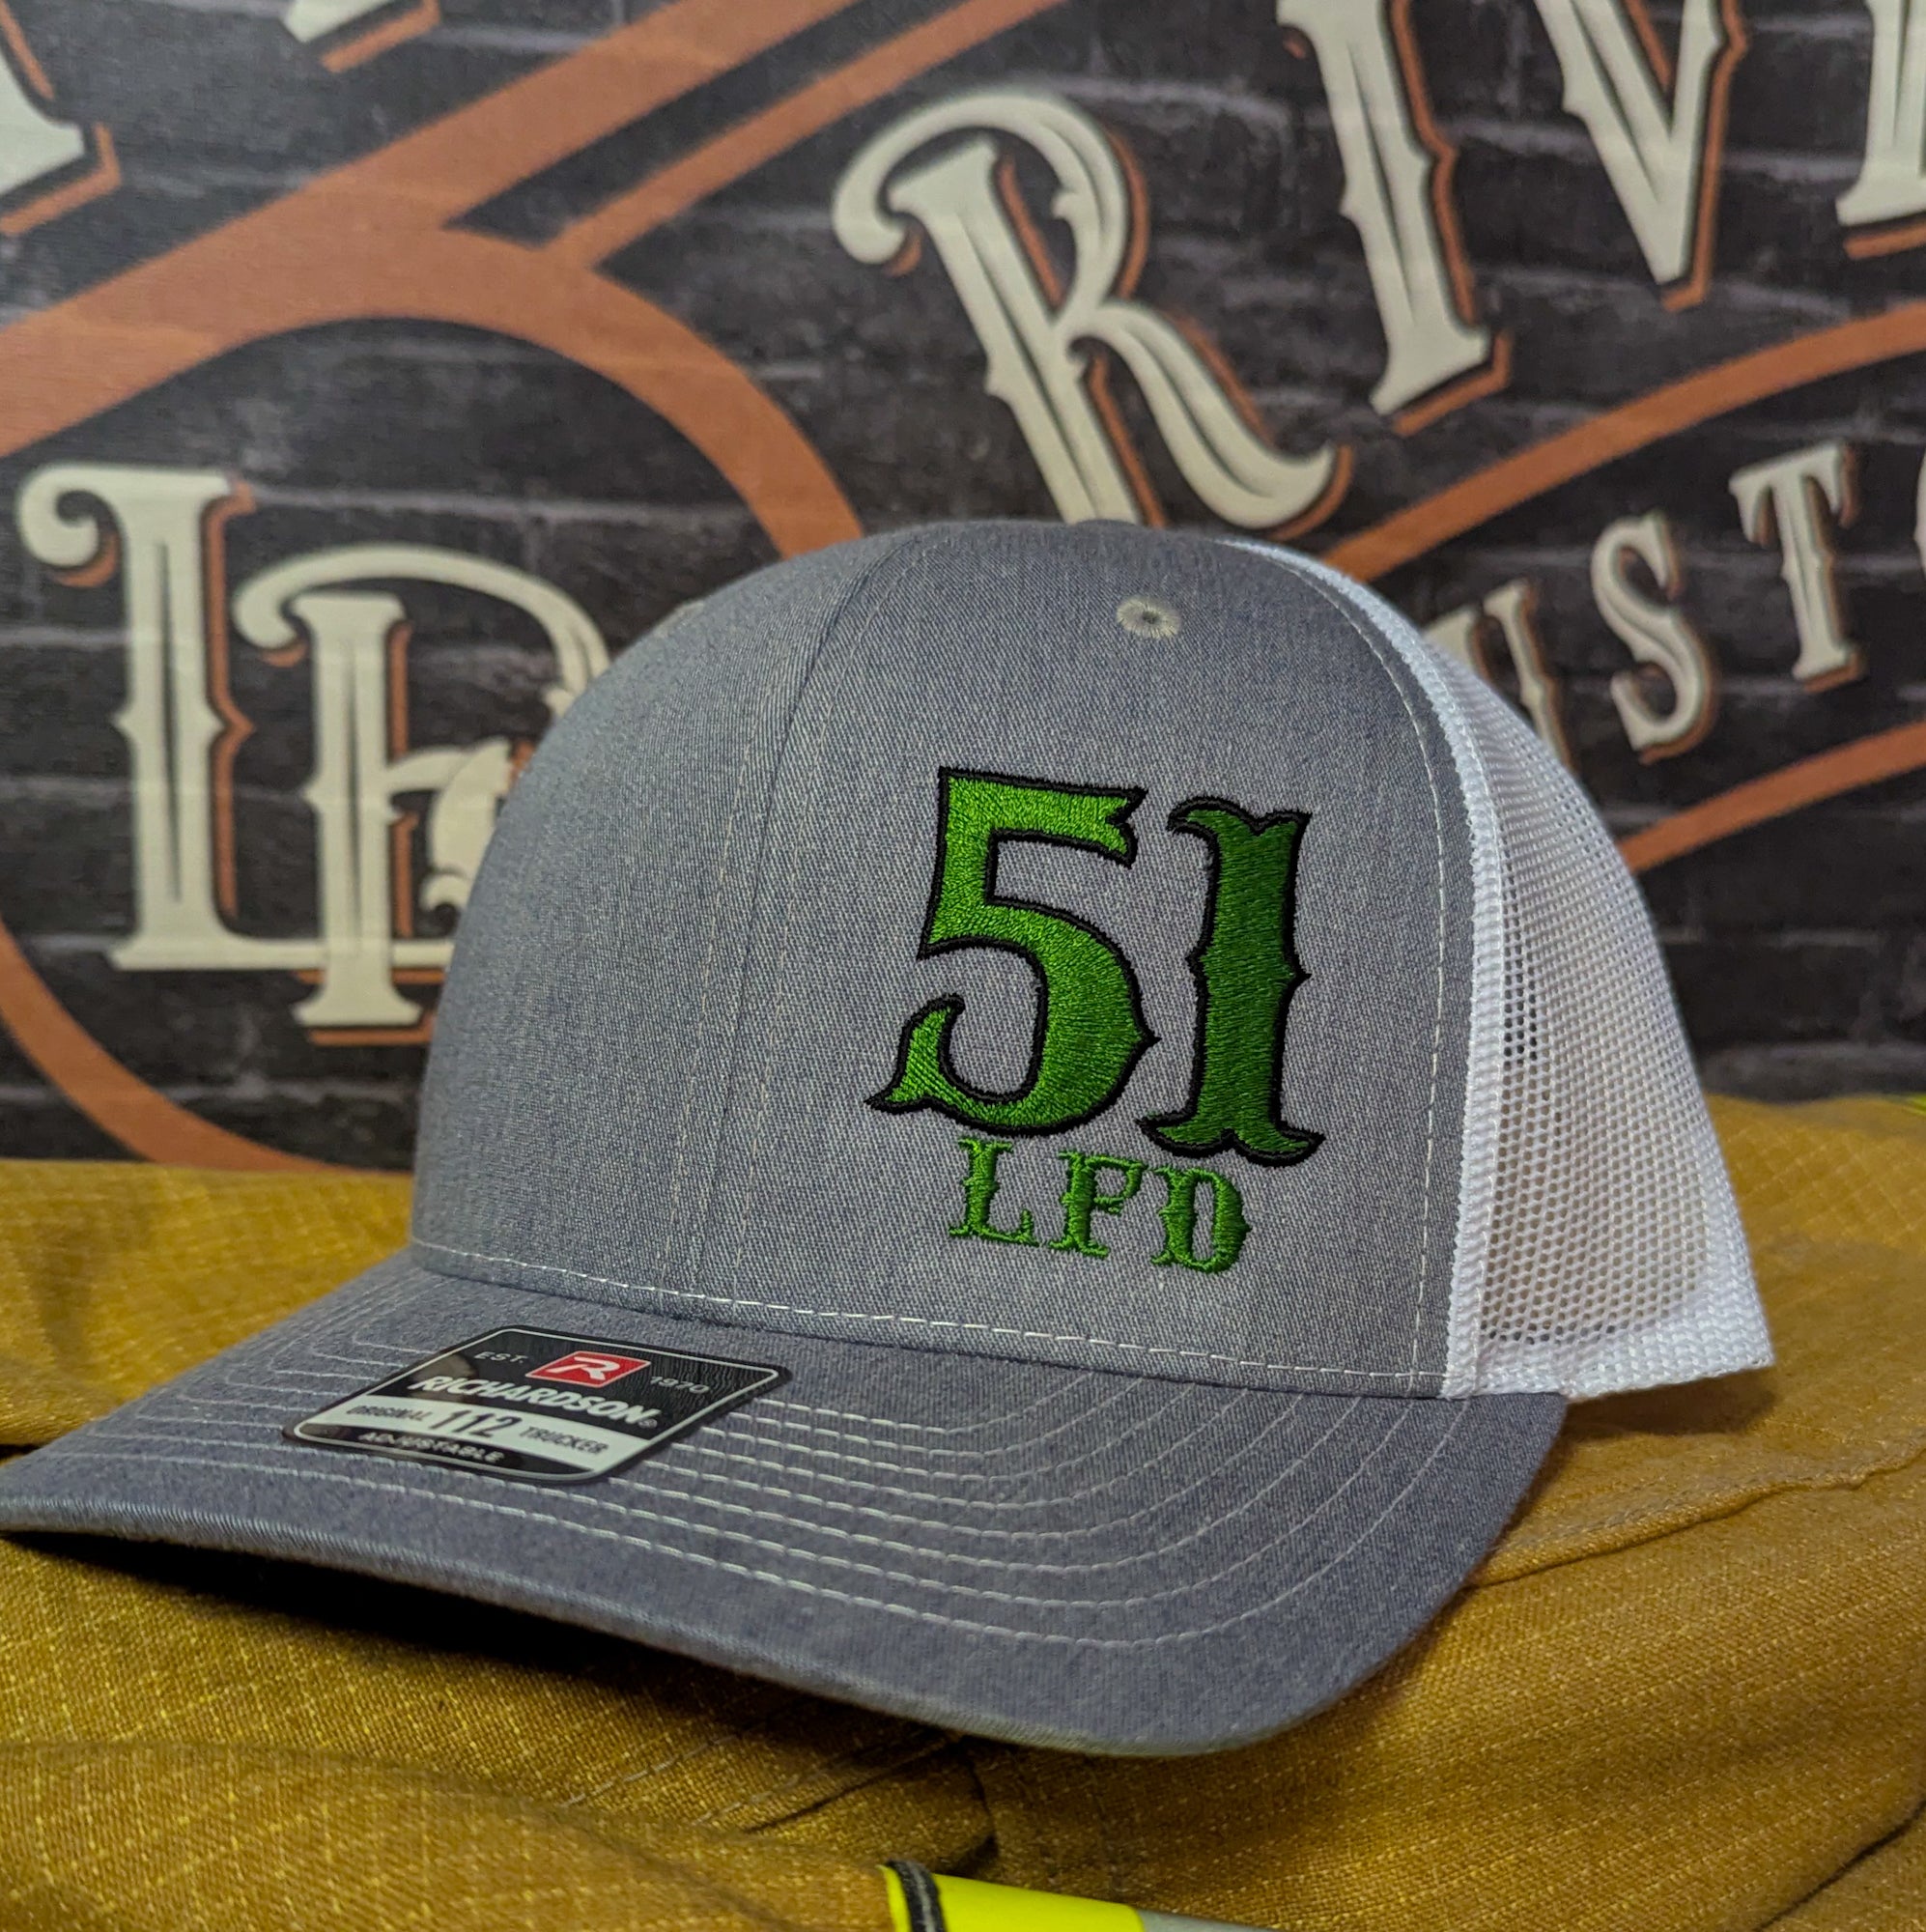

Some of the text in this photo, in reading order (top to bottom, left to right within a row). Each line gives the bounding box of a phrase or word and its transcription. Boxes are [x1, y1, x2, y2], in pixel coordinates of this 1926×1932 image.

[865, 766, 1326, 1167] 51
[474, 1351, 710, 1394] EST. 1970
[428, 1409, 523, 1438] 112
[519, 1426, 609, 1454] TRUCKER
